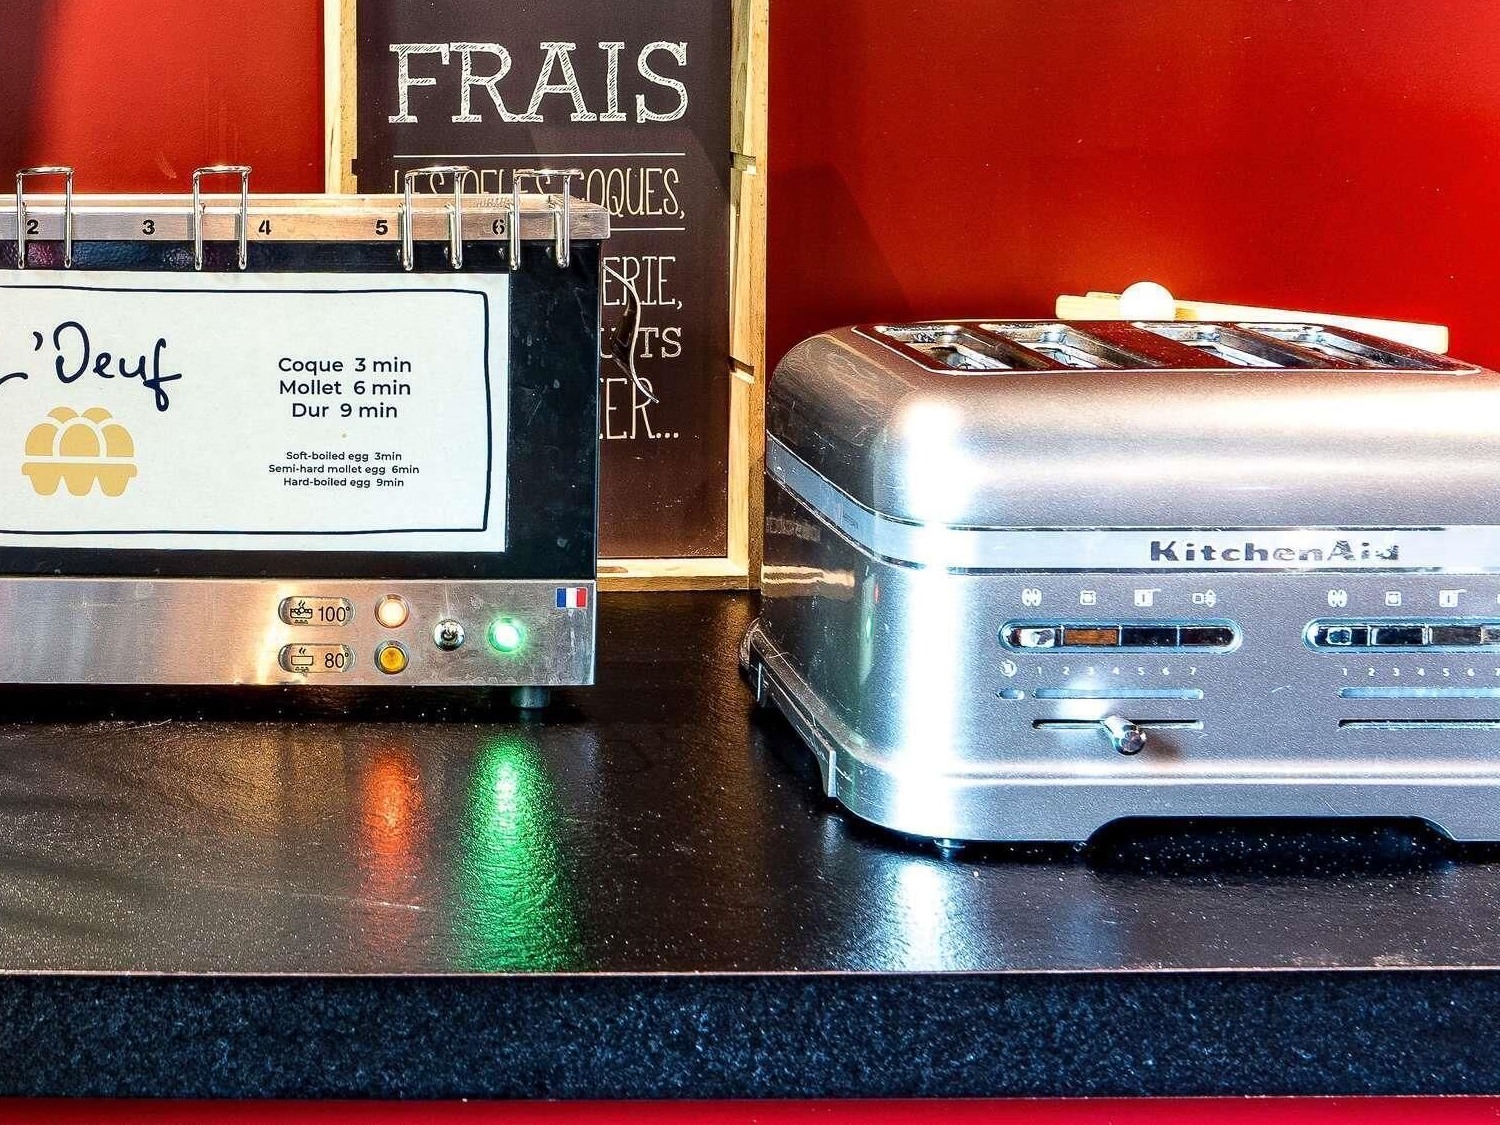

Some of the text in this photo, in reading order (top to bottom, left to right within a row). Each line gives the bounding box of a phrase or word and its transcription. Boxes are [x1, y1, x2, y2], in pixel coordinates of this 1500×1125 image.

[388, 41, 689, 124] FRAIS
[578, 167, 685, 220] OQUES,
[26, 218, 40, 235] 2
[142, 219, 156, 235] 3
[258, 219, 272, 235] 4
[375, 219, 389, 236] 5
[492, 219, 505, 236] 6
[278, 356, 412, 376] Coque 3 min
[279, 379, 411, 395] Mollet 6 min
[292, 402, 398, 418] Dur 9 min
[286, 451, 402, 463] Soft-boiled egg 3min
[268, 464, 420, 476] Semi-hard mollet egg 6min
[283, 477, 405, 489] Hard-boiled egg 9min
[1150, 540, 1400, 562] KitchenAid
[318, 606, 350, 622] 100°
[324, 652, 349, 669] 80°
[1062, 667, 1070, 676] 2
[1087, 667, 1094, 676] 3
[1112, 667, 1120, 676] 4
[1138, 667, 1145, 676] 5
[1162, 667, 1169, 676] 6
[1189, 667, 1197, 676] 7
[1368, 667, 1376, 676] 2
[1392, 667, 1400, 676] 3
[1417, 667, 1425, 676] 4
[1442, 667, 1450, 676] 5
[1467, 667, 1475, 676] 6
